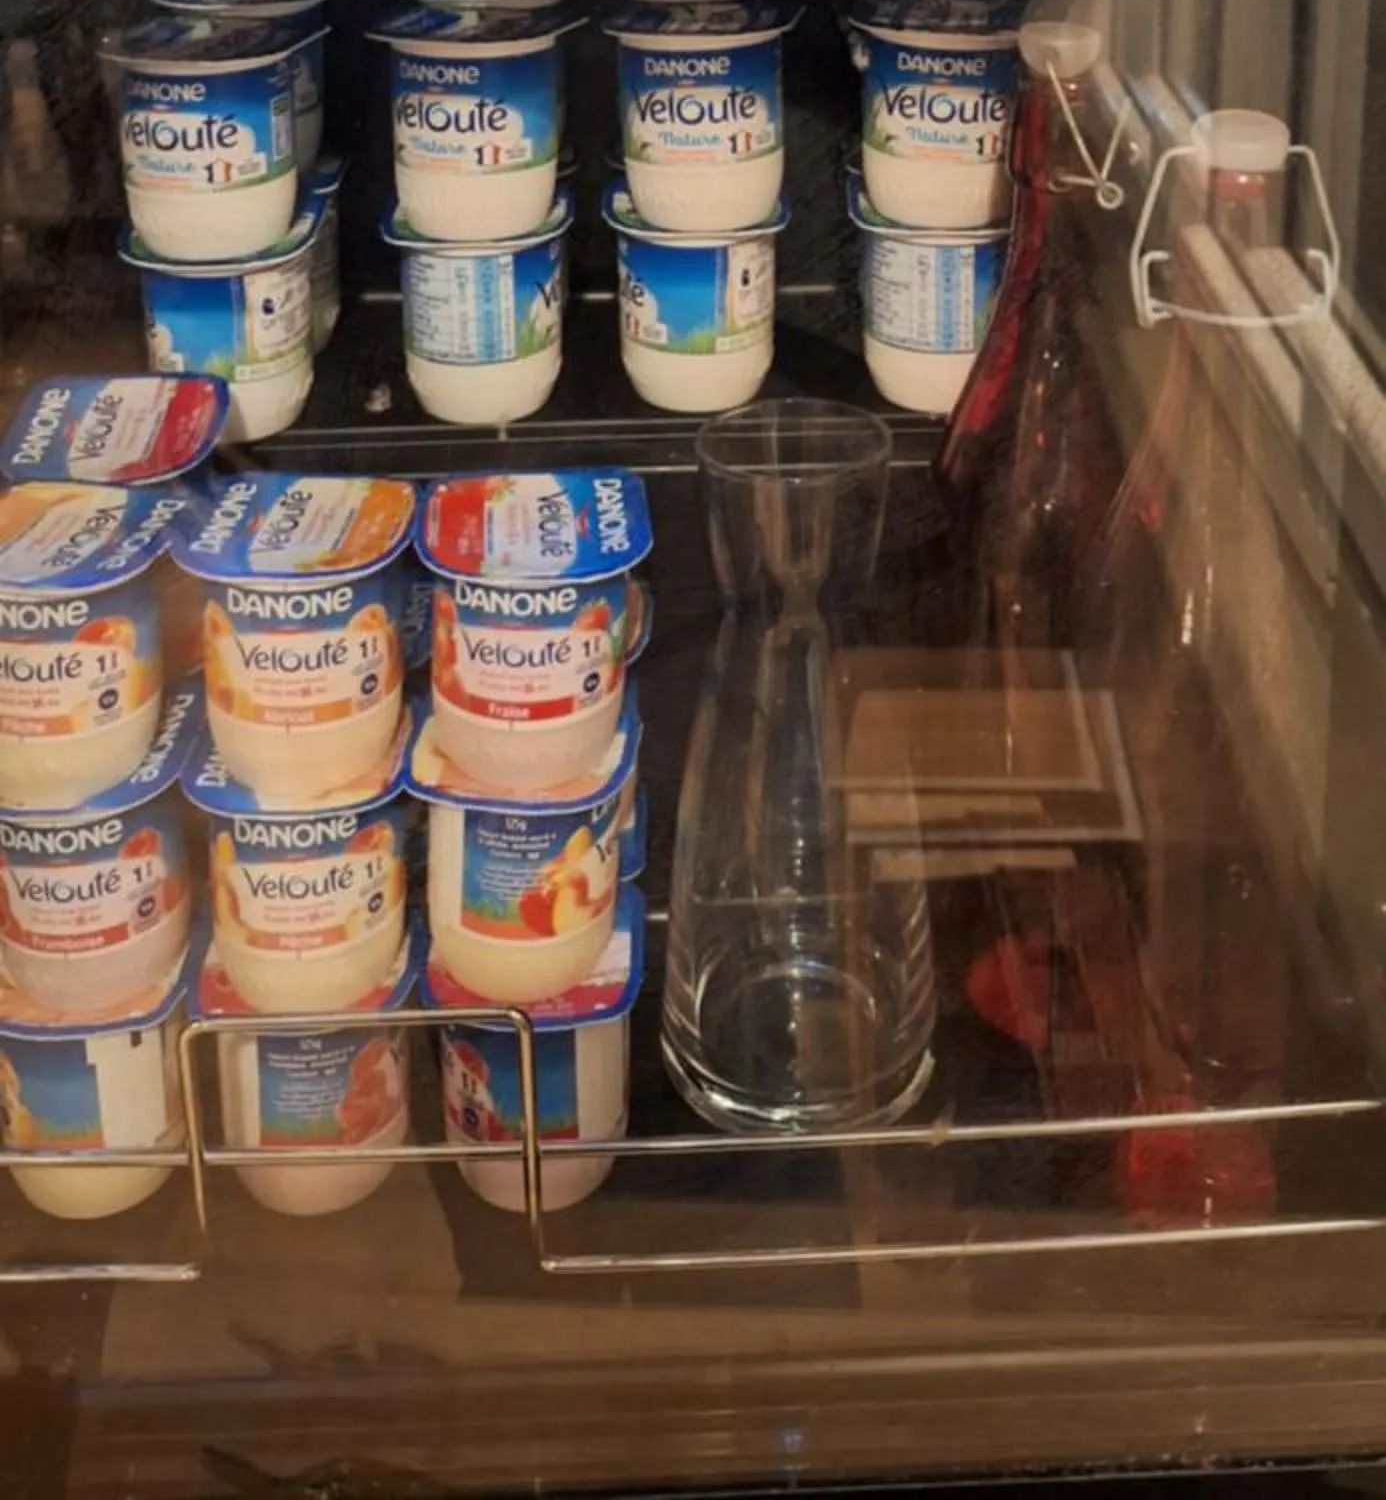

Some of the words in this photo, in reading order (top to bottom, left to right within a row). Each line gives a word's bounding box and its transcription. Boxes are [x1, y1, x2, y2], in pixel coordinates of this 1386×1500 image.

[644, 56, 731, 77] DANONE
[897, 52, 988, 77] DANONE
[10, 387, 71, 465] DANONE
[190, 482, 257, 553] DANONE
[592, 478, 630, 554] DANONE
[0, 599, 89, 630] NONE
[227, 585, 353, 620] DANONE
[455, 582, 577, 616] DANONE
[0, 818, 124, 854] DANONE
[233, 816, 357, 848] DANONE
